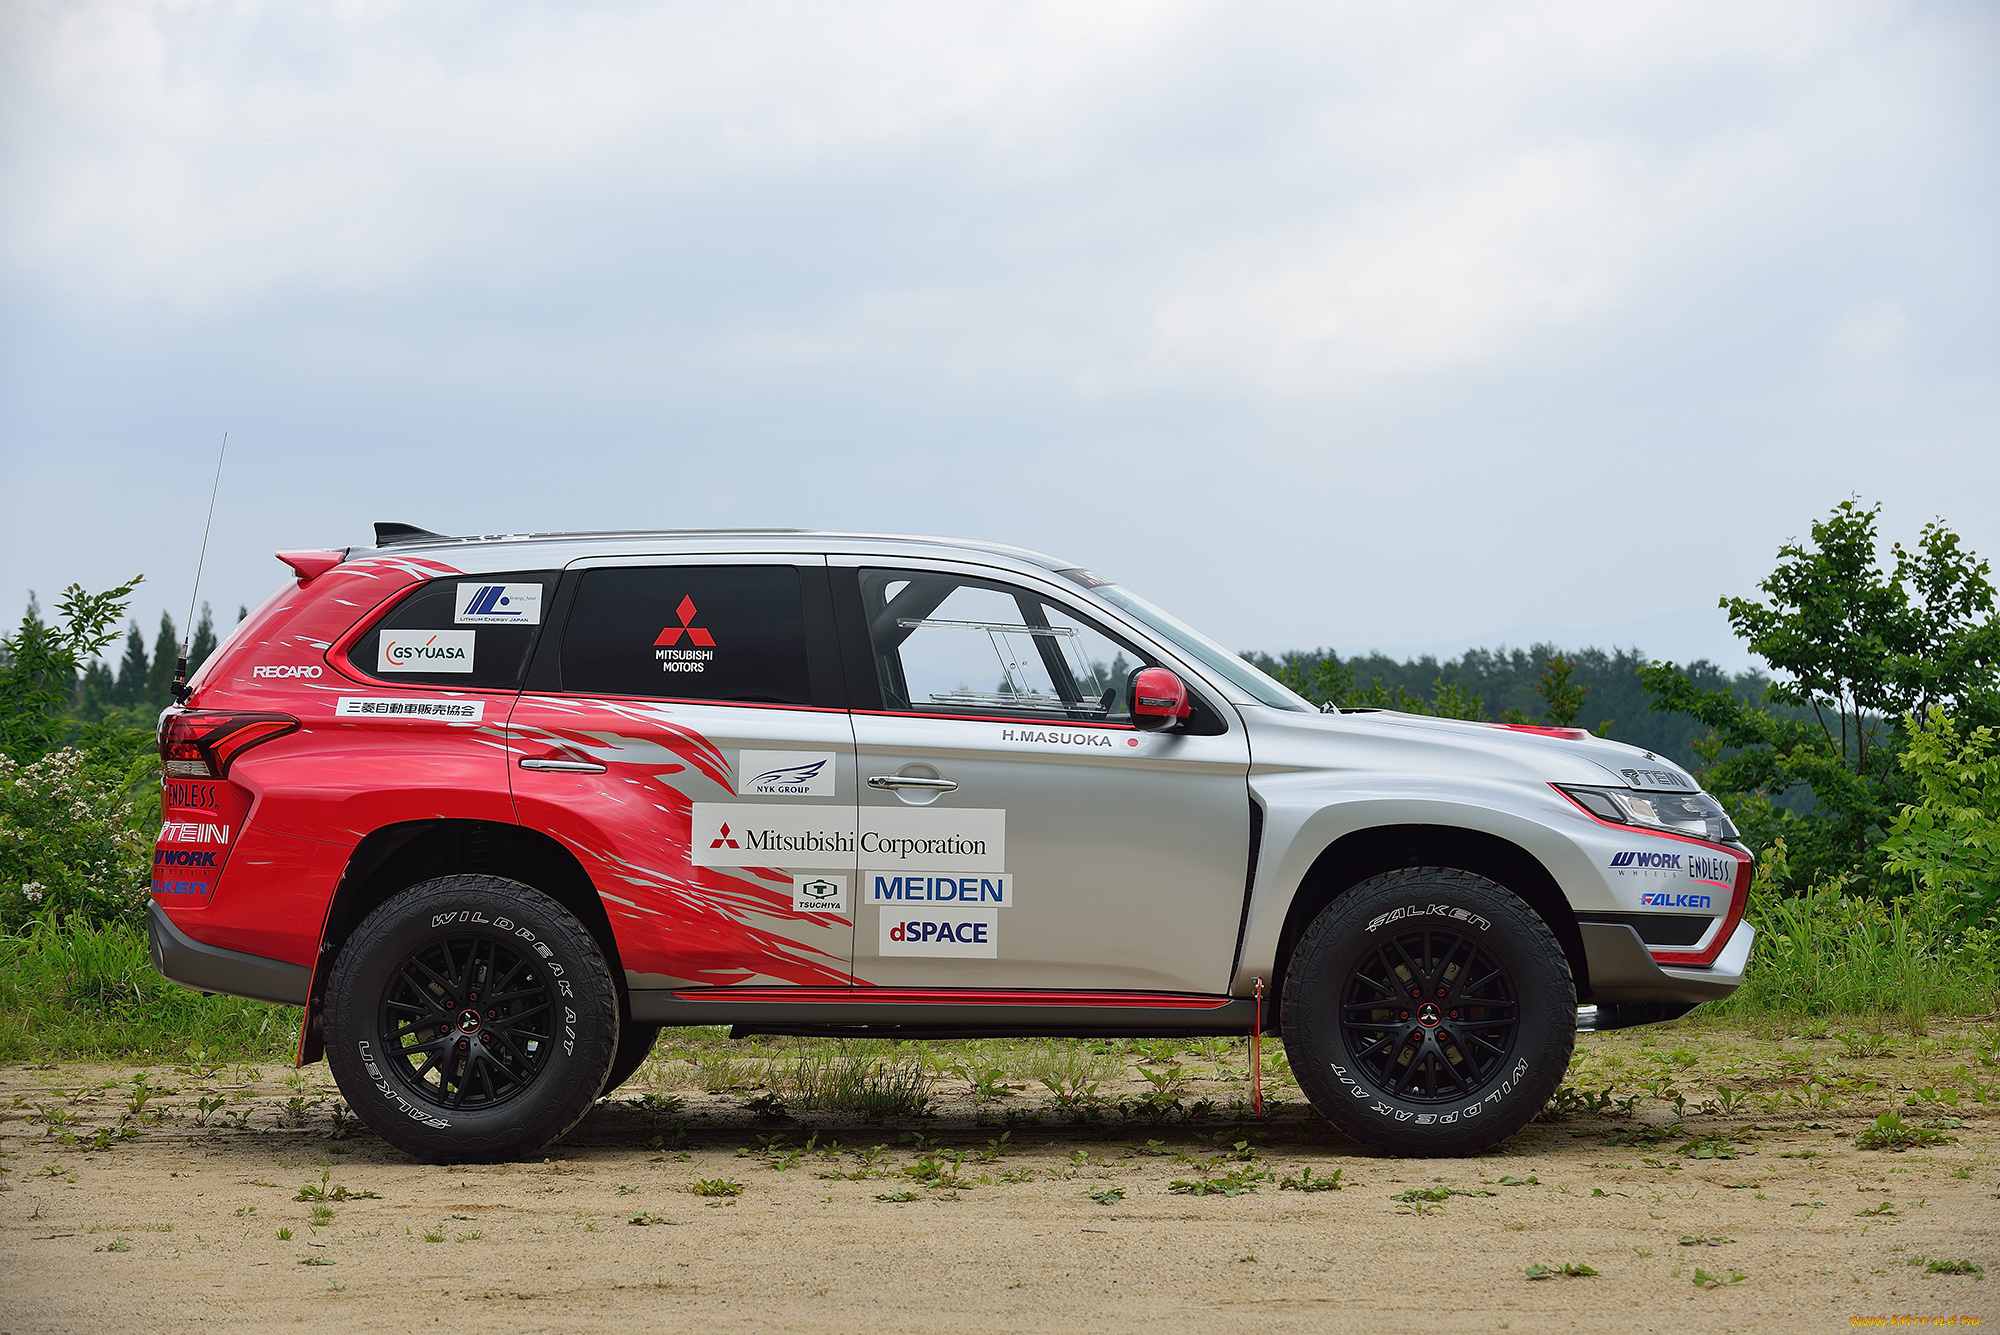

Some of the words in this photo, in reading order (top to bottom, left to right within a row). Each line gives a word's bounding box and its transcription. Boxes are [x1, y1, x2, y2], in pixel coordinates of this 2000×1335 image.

[393, 647, 412, 659] GS
[655, 649, 713, 661] MITSUBISHI
[253, 665, 322, 679] RECARO
[663, 661, 704, 673] MOTORS
[346, 702, 476, 717] 三菱自動車販売協会
[1002, 729, 1112, 747] H.MASUOKA
[1637, 769, 1688, 788] TEIN
[756, 785, 775, 793] NYK
[778, 785, 810, 794] GROUP
[168, 823, 230, 844] TEIN
[745, 829, 855, 852] Mitsubishi
[860, 831, 986, 859] Corporation
[1618, 870, 1676, 878] WHEELS
[874, 876, 1004, 902] MEIDEN
[1638, 893, 1711, 908] FALKEN
[1365, 904, 1492, 933] FALKEN
[889, 921, 988, 944] dSPACE
[431, 910, 573, 998] WILDPEAK
[1370, 1057, 1529, 1125] WILDPEAK
